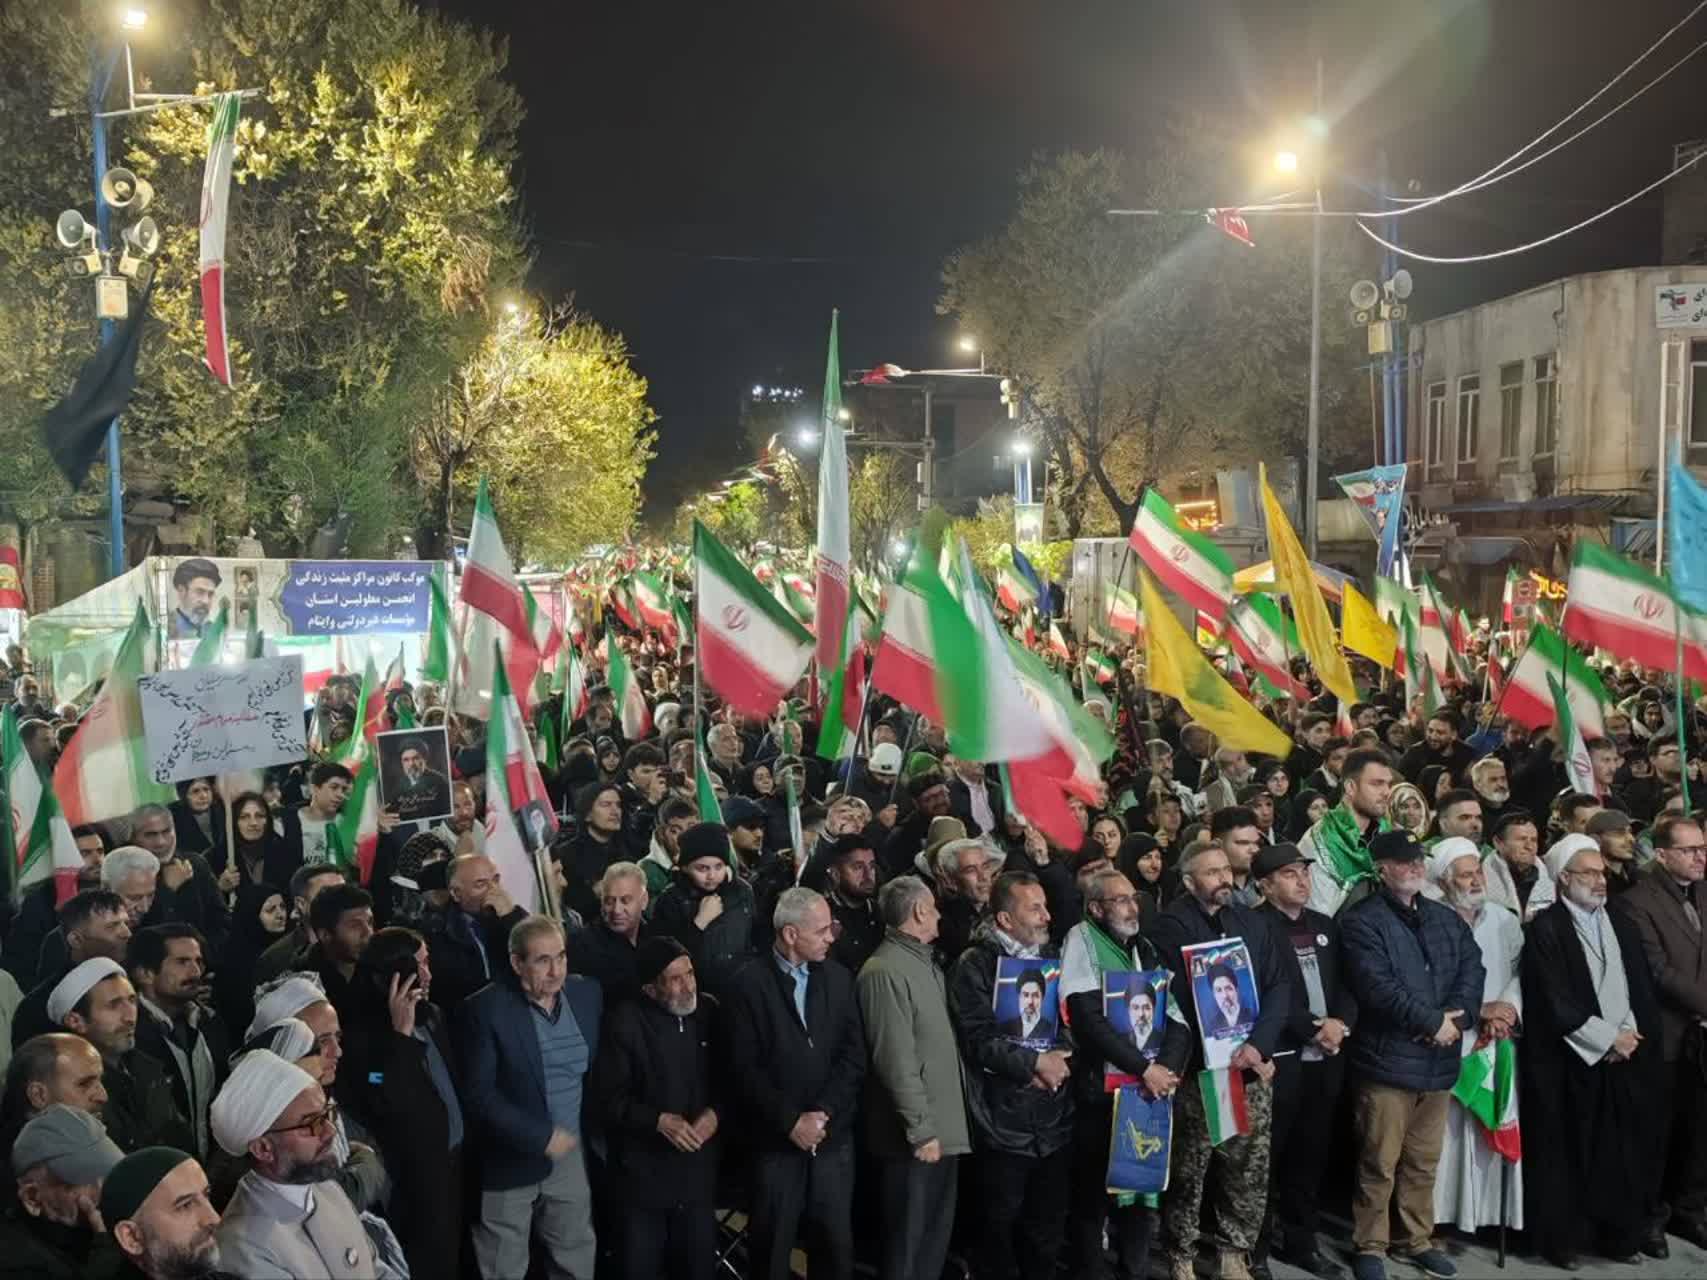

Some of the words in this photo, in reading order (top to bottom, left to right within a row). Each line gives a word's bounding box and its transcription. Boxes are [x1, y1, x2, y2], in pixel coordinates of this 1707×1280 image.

[295, 571, 328, 586] زندگی
[352, 571, 376, 586] مراکز
[377, 571, 401, 586] کانون
[402, 572, 425, 586] موکب
[305, 592, 338, 608] استان
[340, 593, 380, 608] معلولین
[382, 592, 416, 606] انجمن
